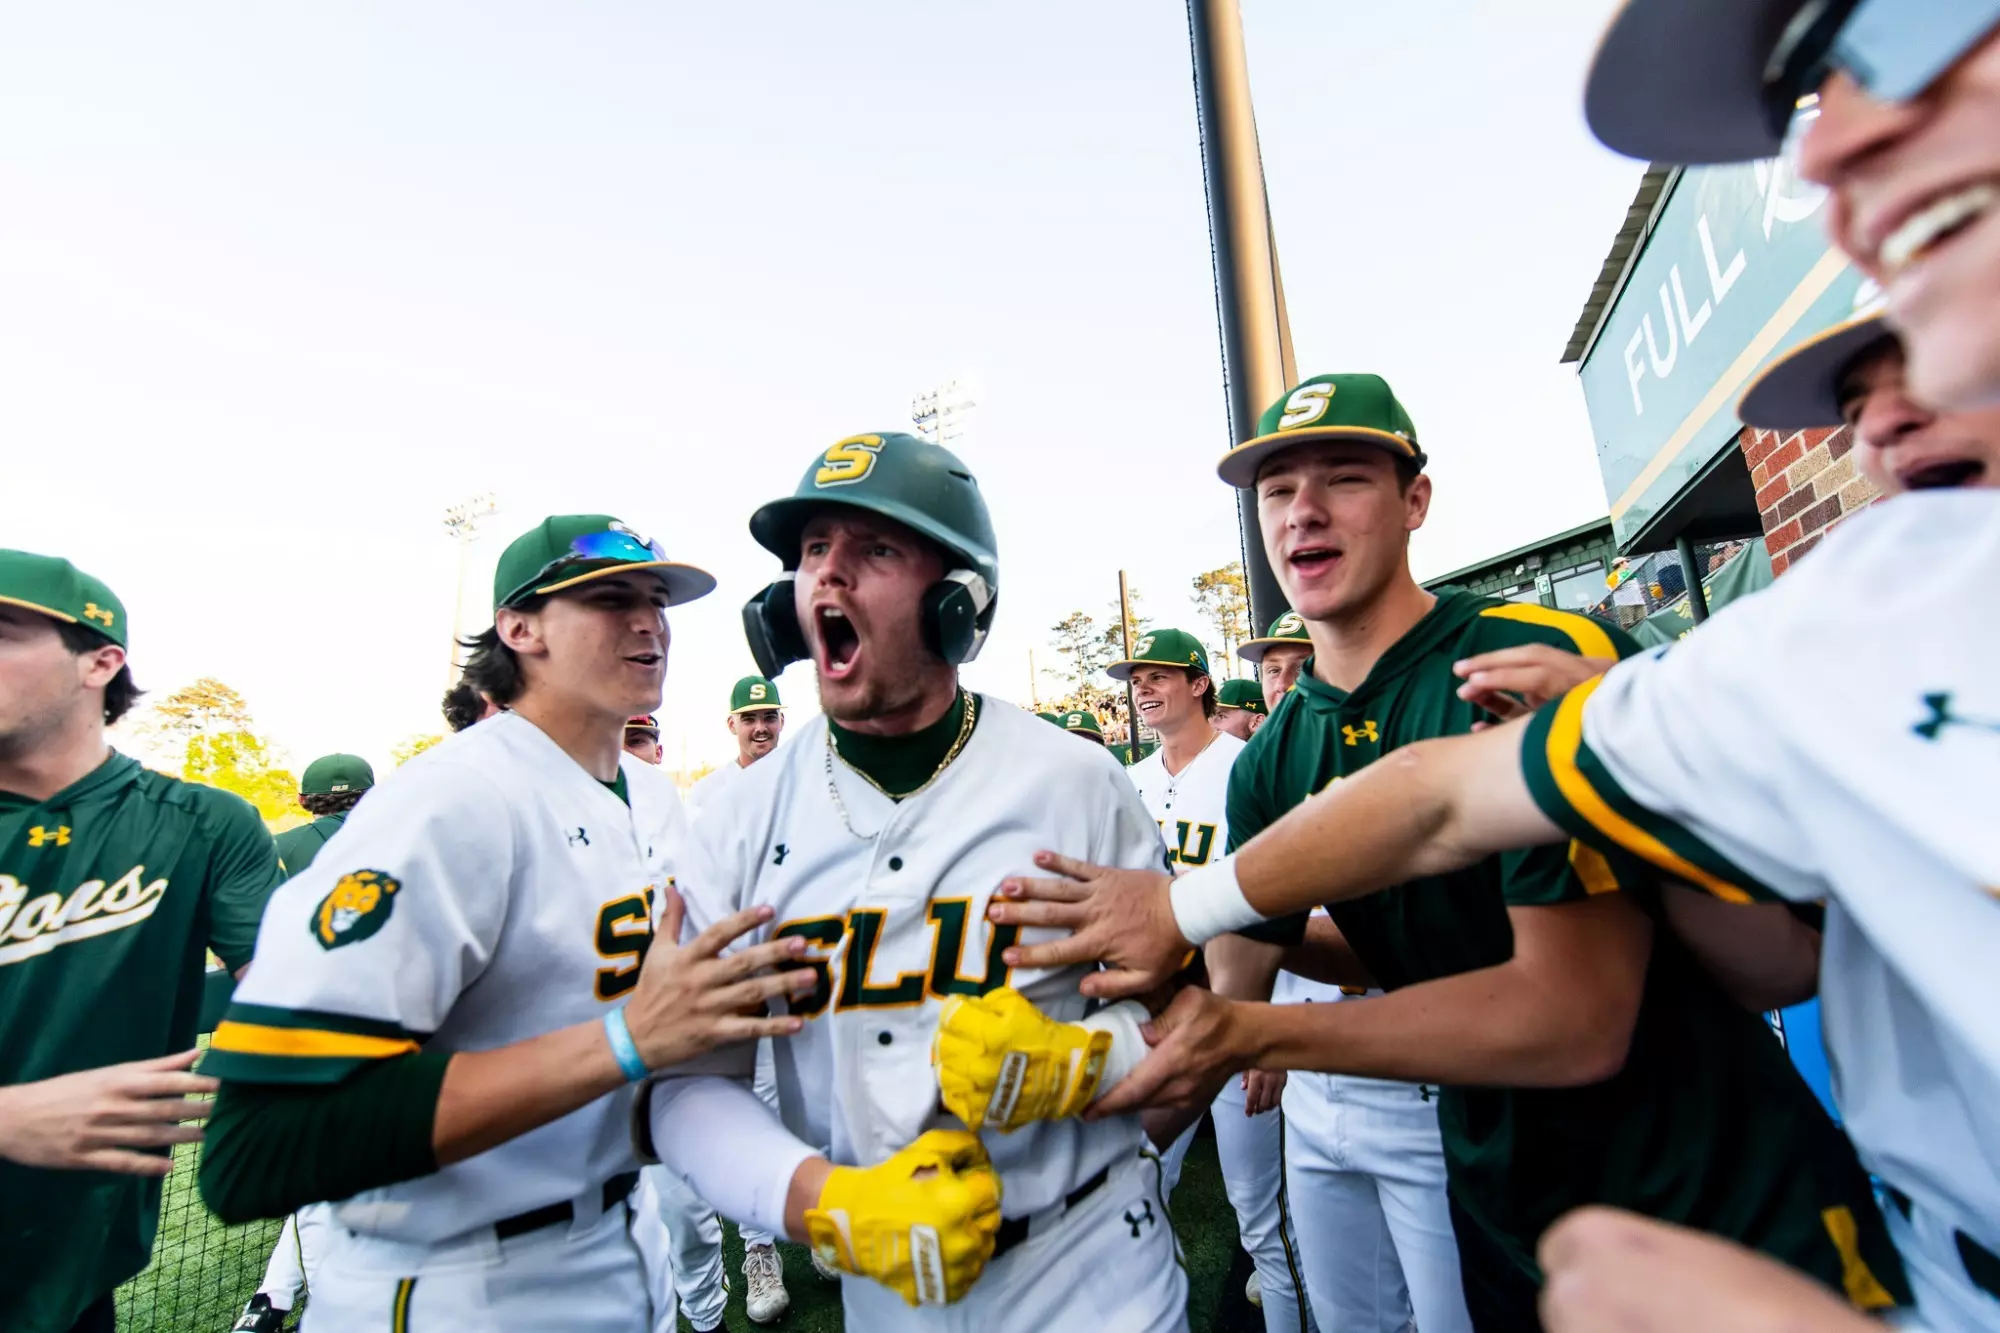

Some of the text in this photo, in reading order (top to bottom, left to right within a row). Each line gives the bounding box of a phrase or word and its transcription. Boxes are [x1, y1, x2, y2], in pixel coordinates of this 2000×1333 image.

[1624, 213, 1747, 417] FULL
[1278, 382, 1336, 431] S
[815, 434, 886, 489] S
[1275, 612, 1304, 637] S
[1132, 636, 1155, 659] S
[750, 683, 767, 700] S
[1067, 713, 1082, 728] S
[773, 896, 1025, 1020] SLU
